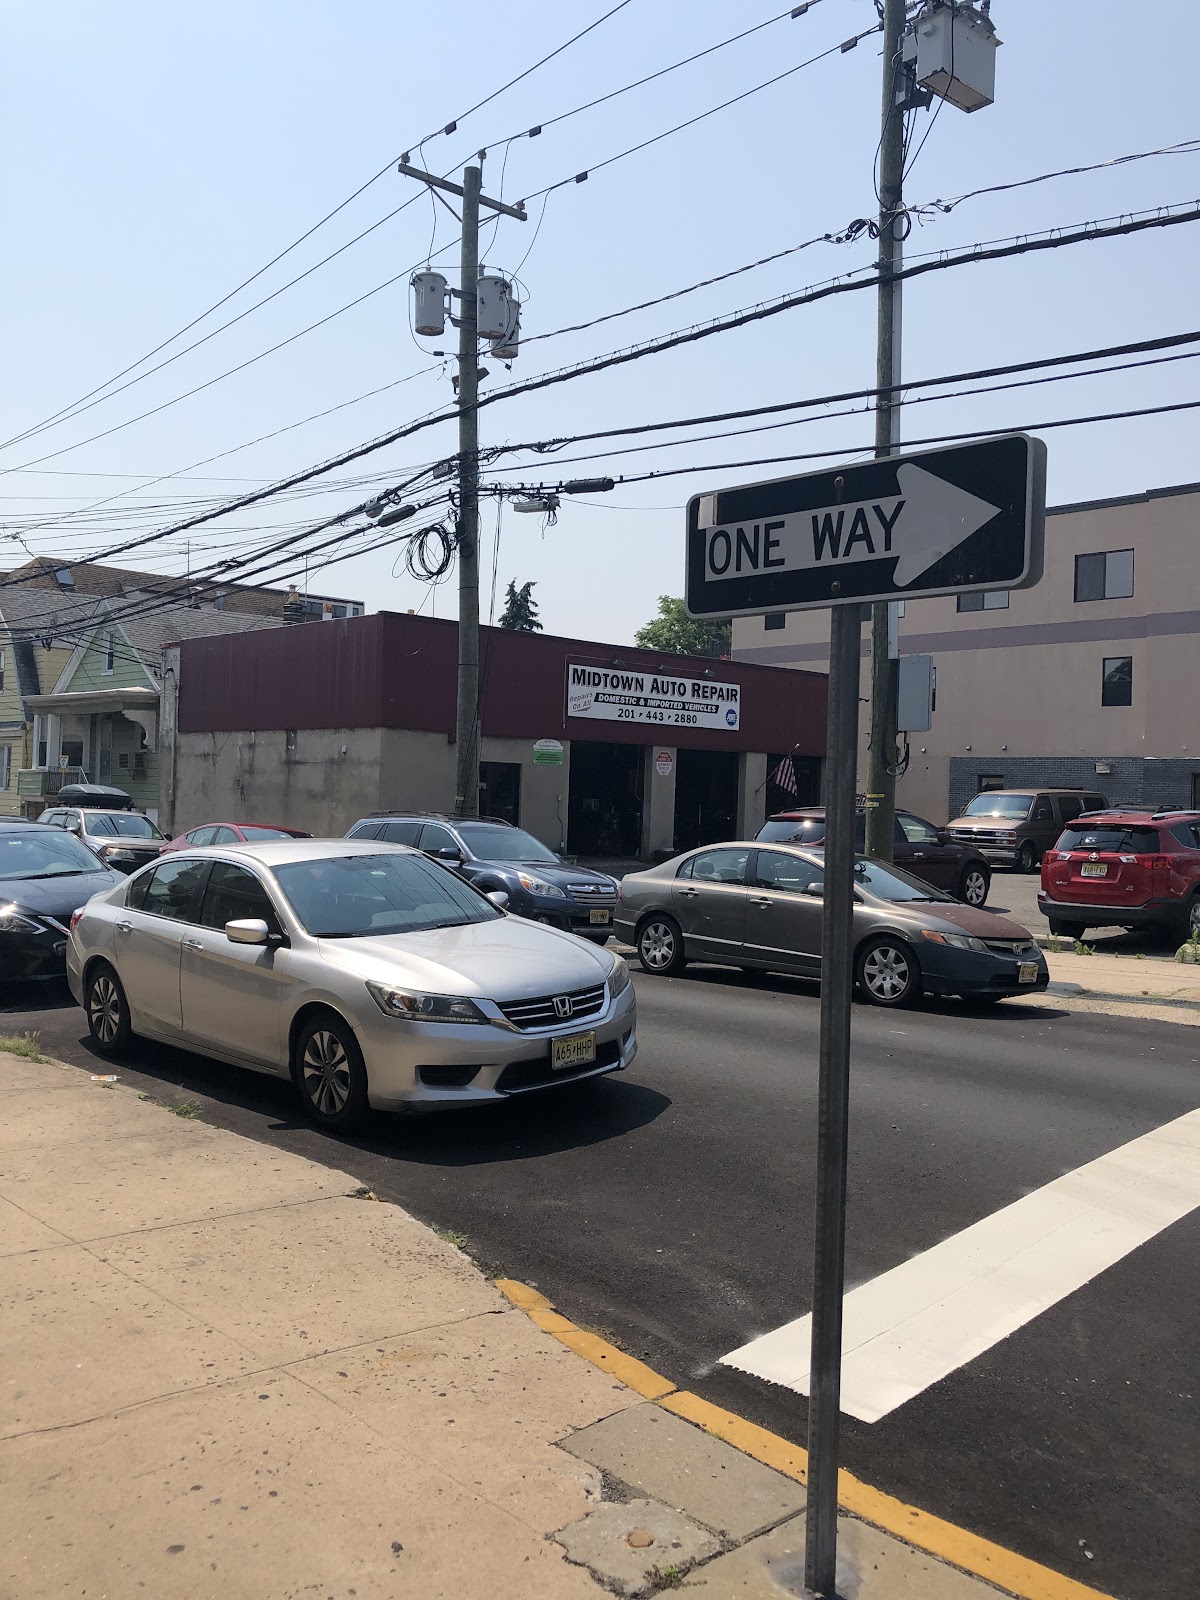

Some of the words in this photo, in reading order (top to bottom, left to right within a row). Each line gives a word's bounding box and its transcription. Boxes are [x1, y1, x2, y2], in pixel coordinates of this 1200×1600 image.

[708, 520, 786, 576] ONE
[811, 500, 905, 562] WAY
[571, 667, 644, 693] MIDTOWN
[649, 677, 687, 697] AUTO
[691, 682, 739, 703] REPAIR
[598, 693, 637, 705] DOMESTIC
[639, 698, 645, 706] &
[646, 699, 683, 710] IMPORTED
[685, 702, 717, 713] VEHICLES
[617, 708, 635, 719] 201
[645, 711, 664, 722] 443
[674, 713, 698, 724] 2880
